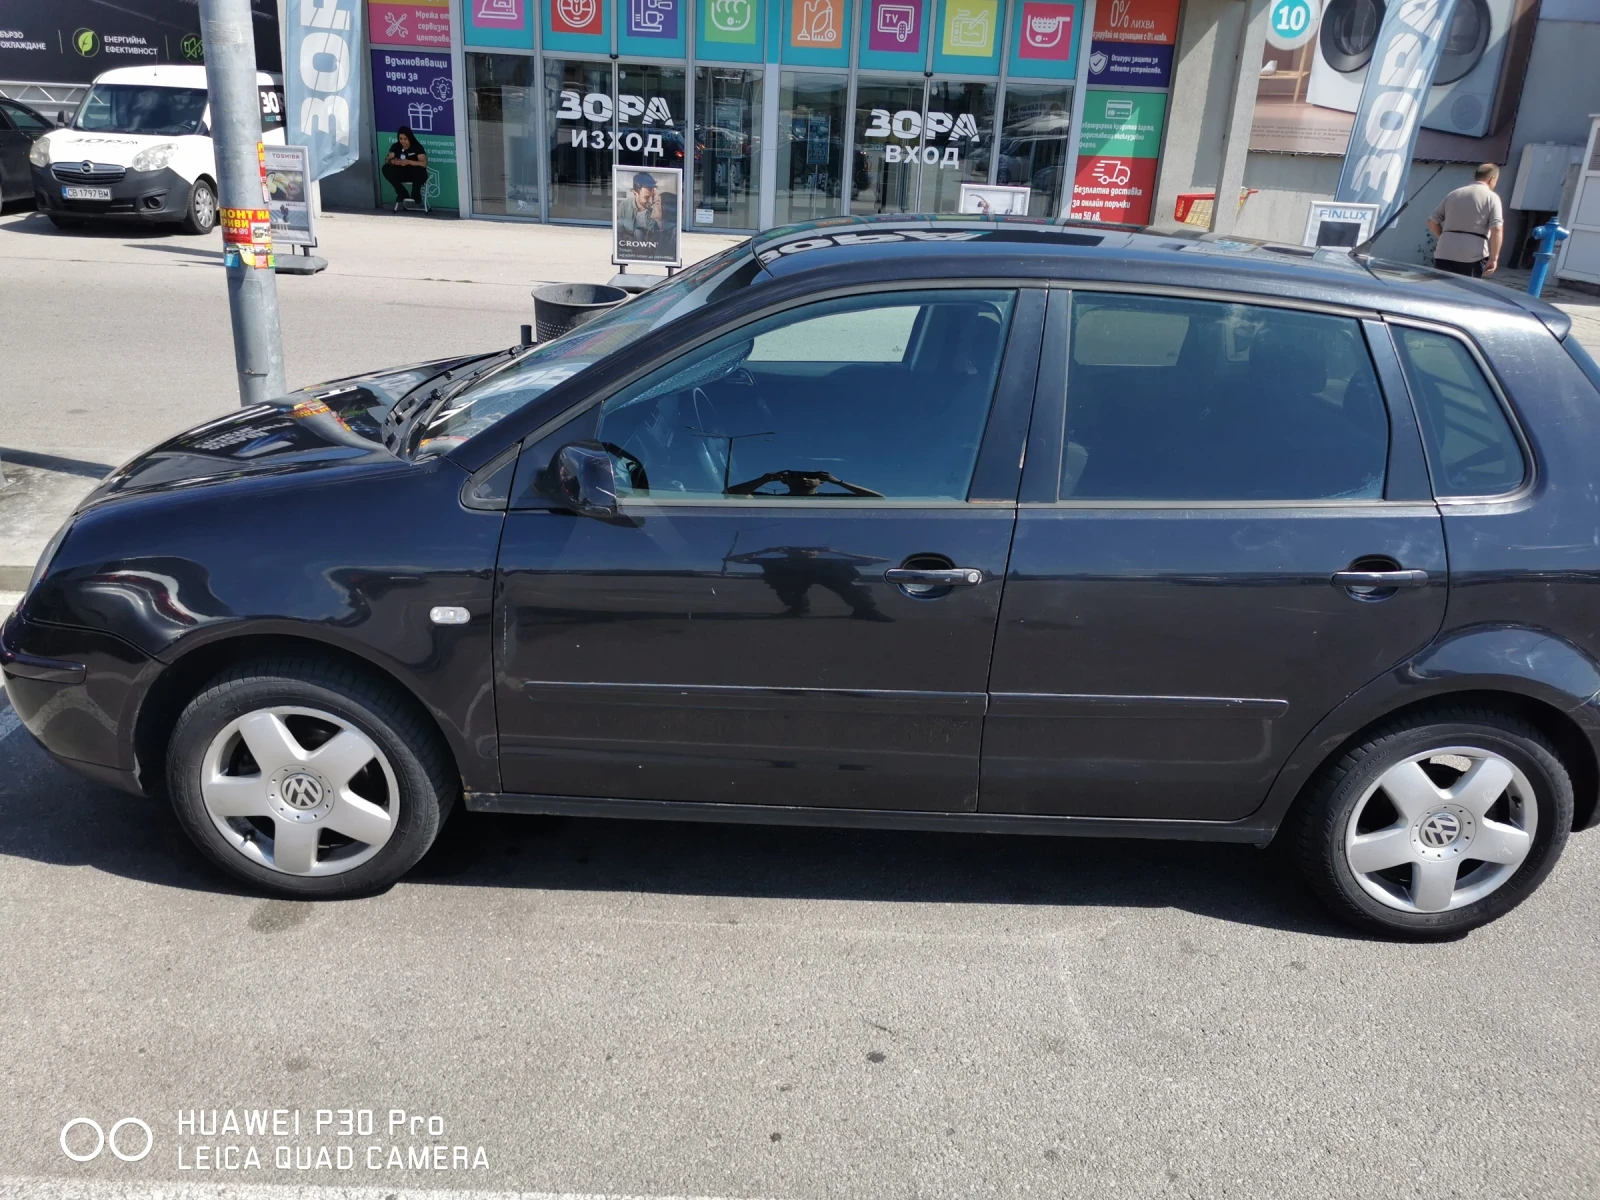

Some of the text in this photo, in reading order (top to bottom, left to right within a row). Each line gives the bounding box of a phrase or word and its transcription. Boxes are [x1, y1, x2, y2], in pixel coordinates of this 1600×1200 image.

[415, 10, 439, 20] Мрежа
[885, 13, 899, 24] TV
[1110, 0, 1155, 29] 0% ЛИХВА
[1277, 5, 1306, 31] 10
[418, 22, 449, 32] сервизни
[104, 35, 147, 45] ЕНЕРГИЙНА
[416, 34, 451, 43] центрове.
[0, 41, 47, 50] ОХЛАЖДАНЕ
[105, 45, 158, 56] ЕФЕКТИВНОСТ
[385, 55, 448, 69] Вдъхновяващи
[386, 71, 419, 82] идеи за
[387, 84, 430, 95] подаръци.
[556, 91, 674, 126] ЗОРА
[865, 109, 980, 142] ЗОРА
[572, 129, 664, 157] ИЗХОД
[272, 152, 300, 160] TOSHIBA
[886, 145, 959, 170] ВХОД
[80, 188, 97, 198] 1797
[1074, 185, 1142, 196] Безплатна доставка
[1072, 198, 1131, 209] за онлайн поръчки
[1083, 211, 1091, 221] 50
[1091, 211, 1101, 221] лв.
[1319, 209, 1368, 221] FINLUX
[618, 240, 657, 248] CROWN
